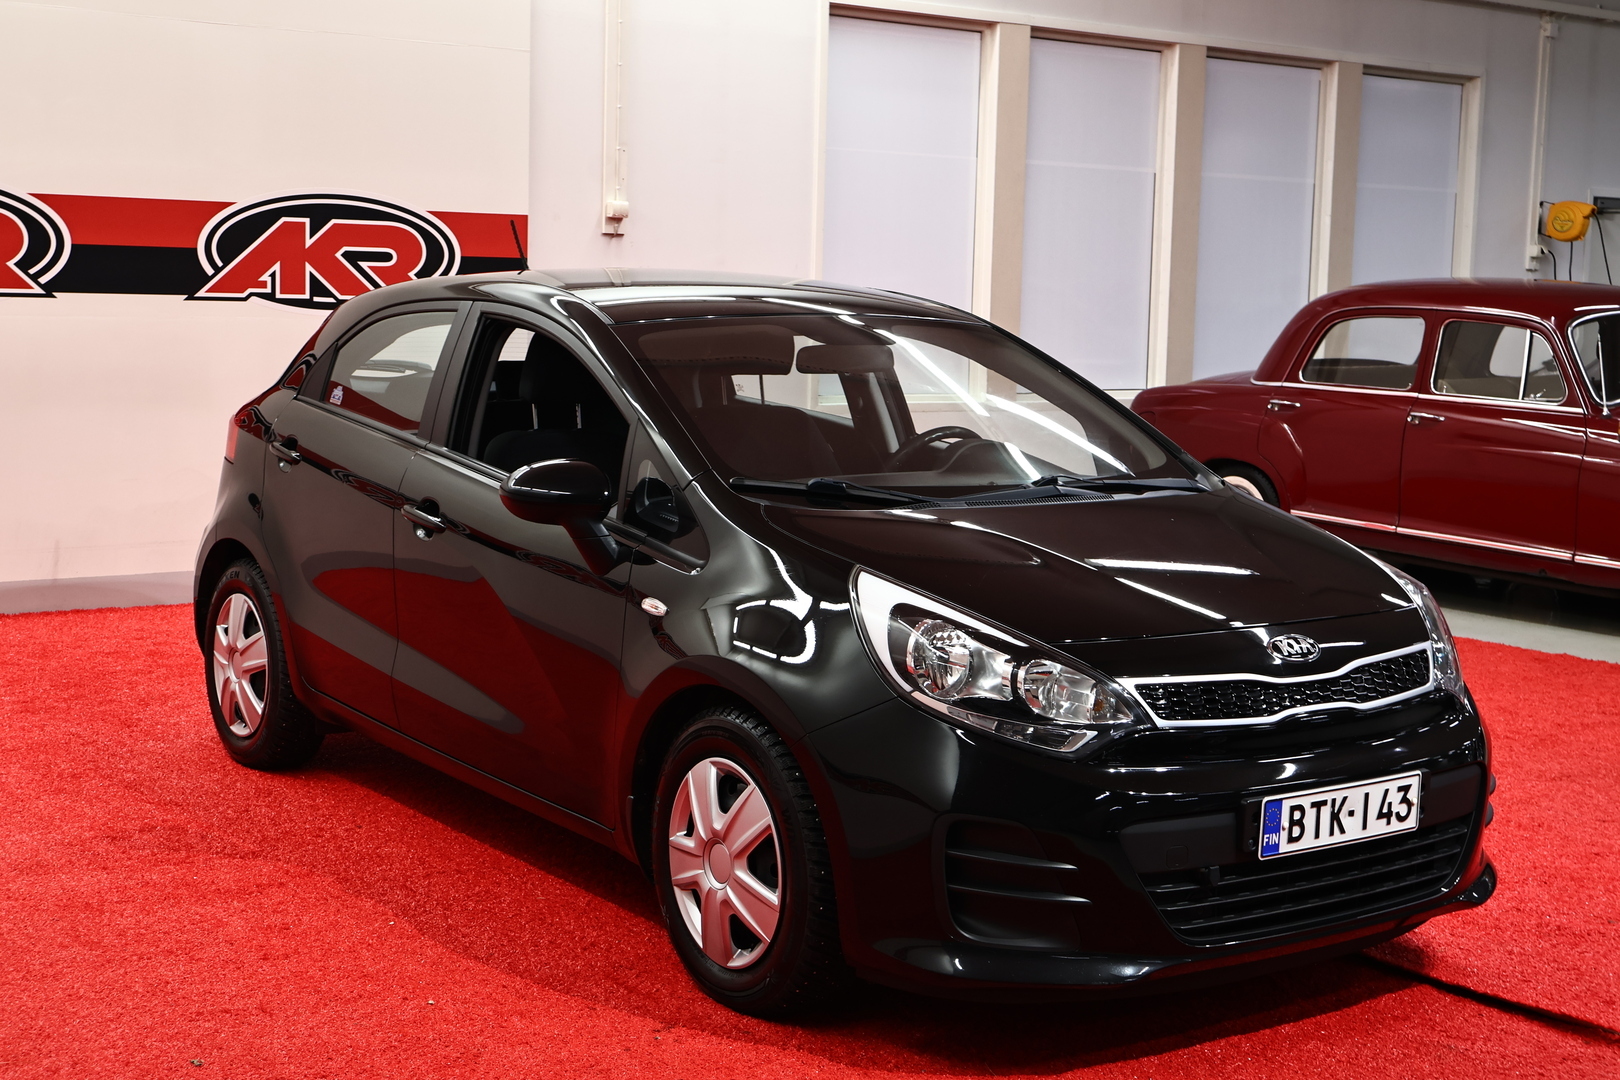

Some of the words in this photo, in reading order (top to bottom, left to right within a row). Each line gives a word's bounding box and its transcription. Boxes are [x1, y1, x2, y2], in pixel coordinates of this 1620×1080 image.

[192, 217, 427, 299] AKR
[1273, 637, 1316, 657] KIA
[1286, 783, 1414, 845] BTK-143
[1263, 832, 1280, 847] FIN
